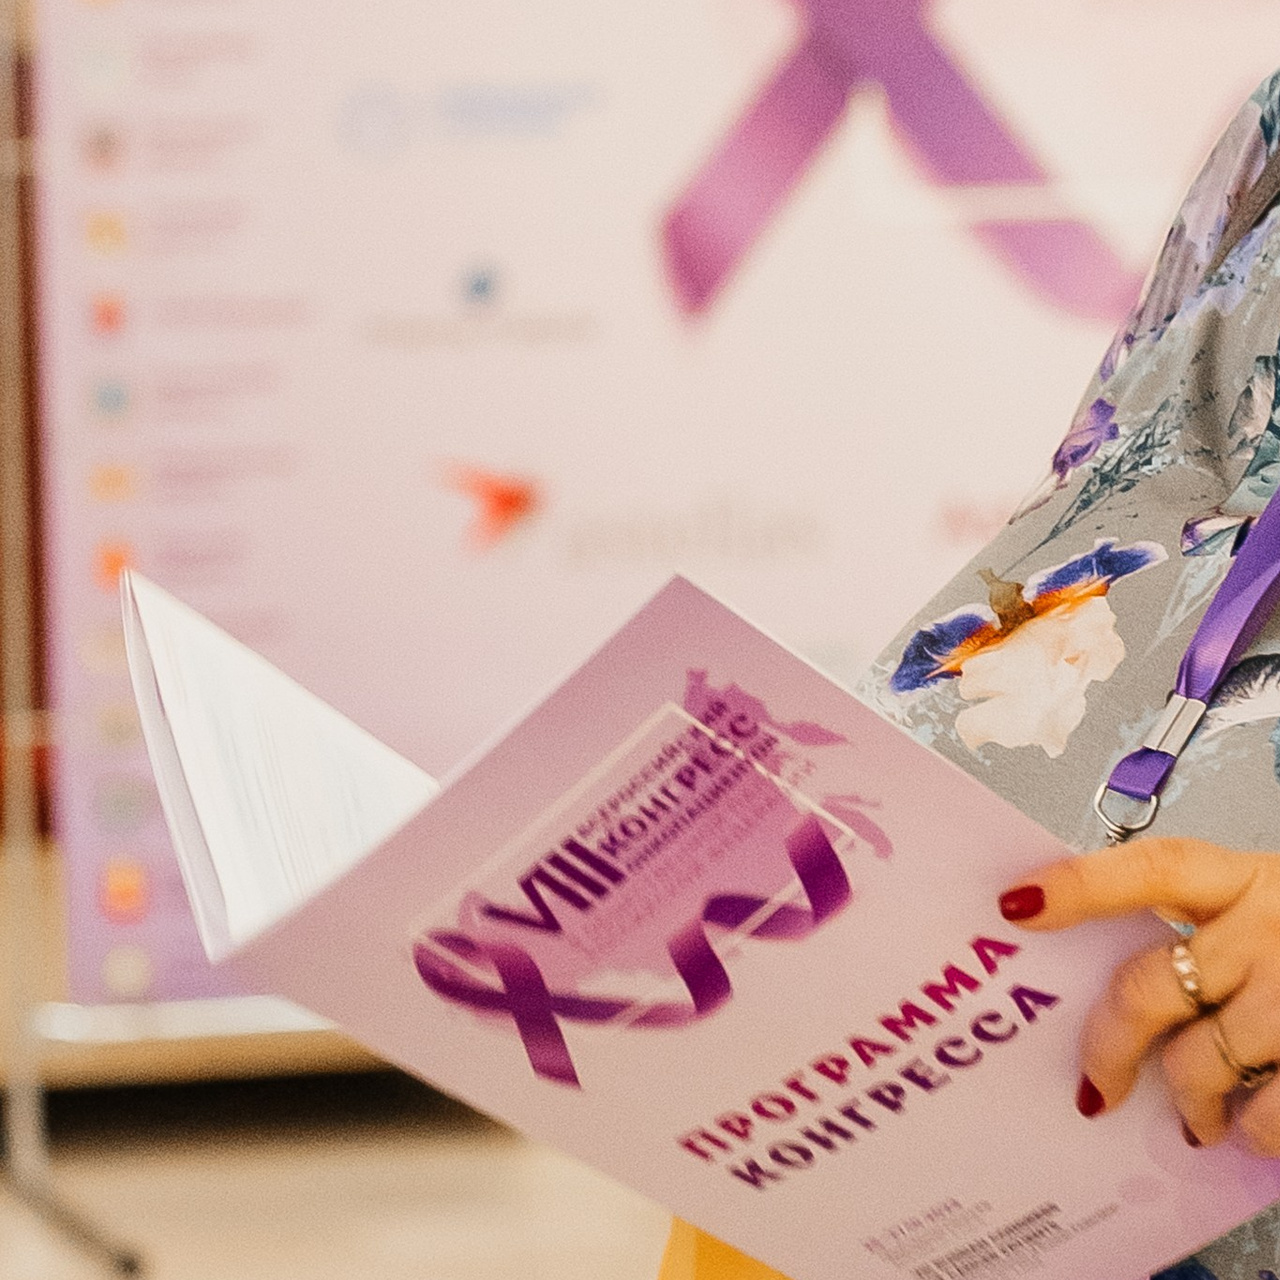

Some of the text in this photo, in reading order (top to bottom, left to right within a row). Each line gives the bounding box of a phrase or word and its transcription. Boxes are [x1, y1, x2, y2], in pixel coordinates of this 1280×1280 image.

[598, 713, 758, 859] КОНГРЕСС
[480, 836, 626, 934] VIII
[677, 934, 1021, 1163] ПРОГРАММА
[728, 983, 1061, 1190] КОНГРЕССА
